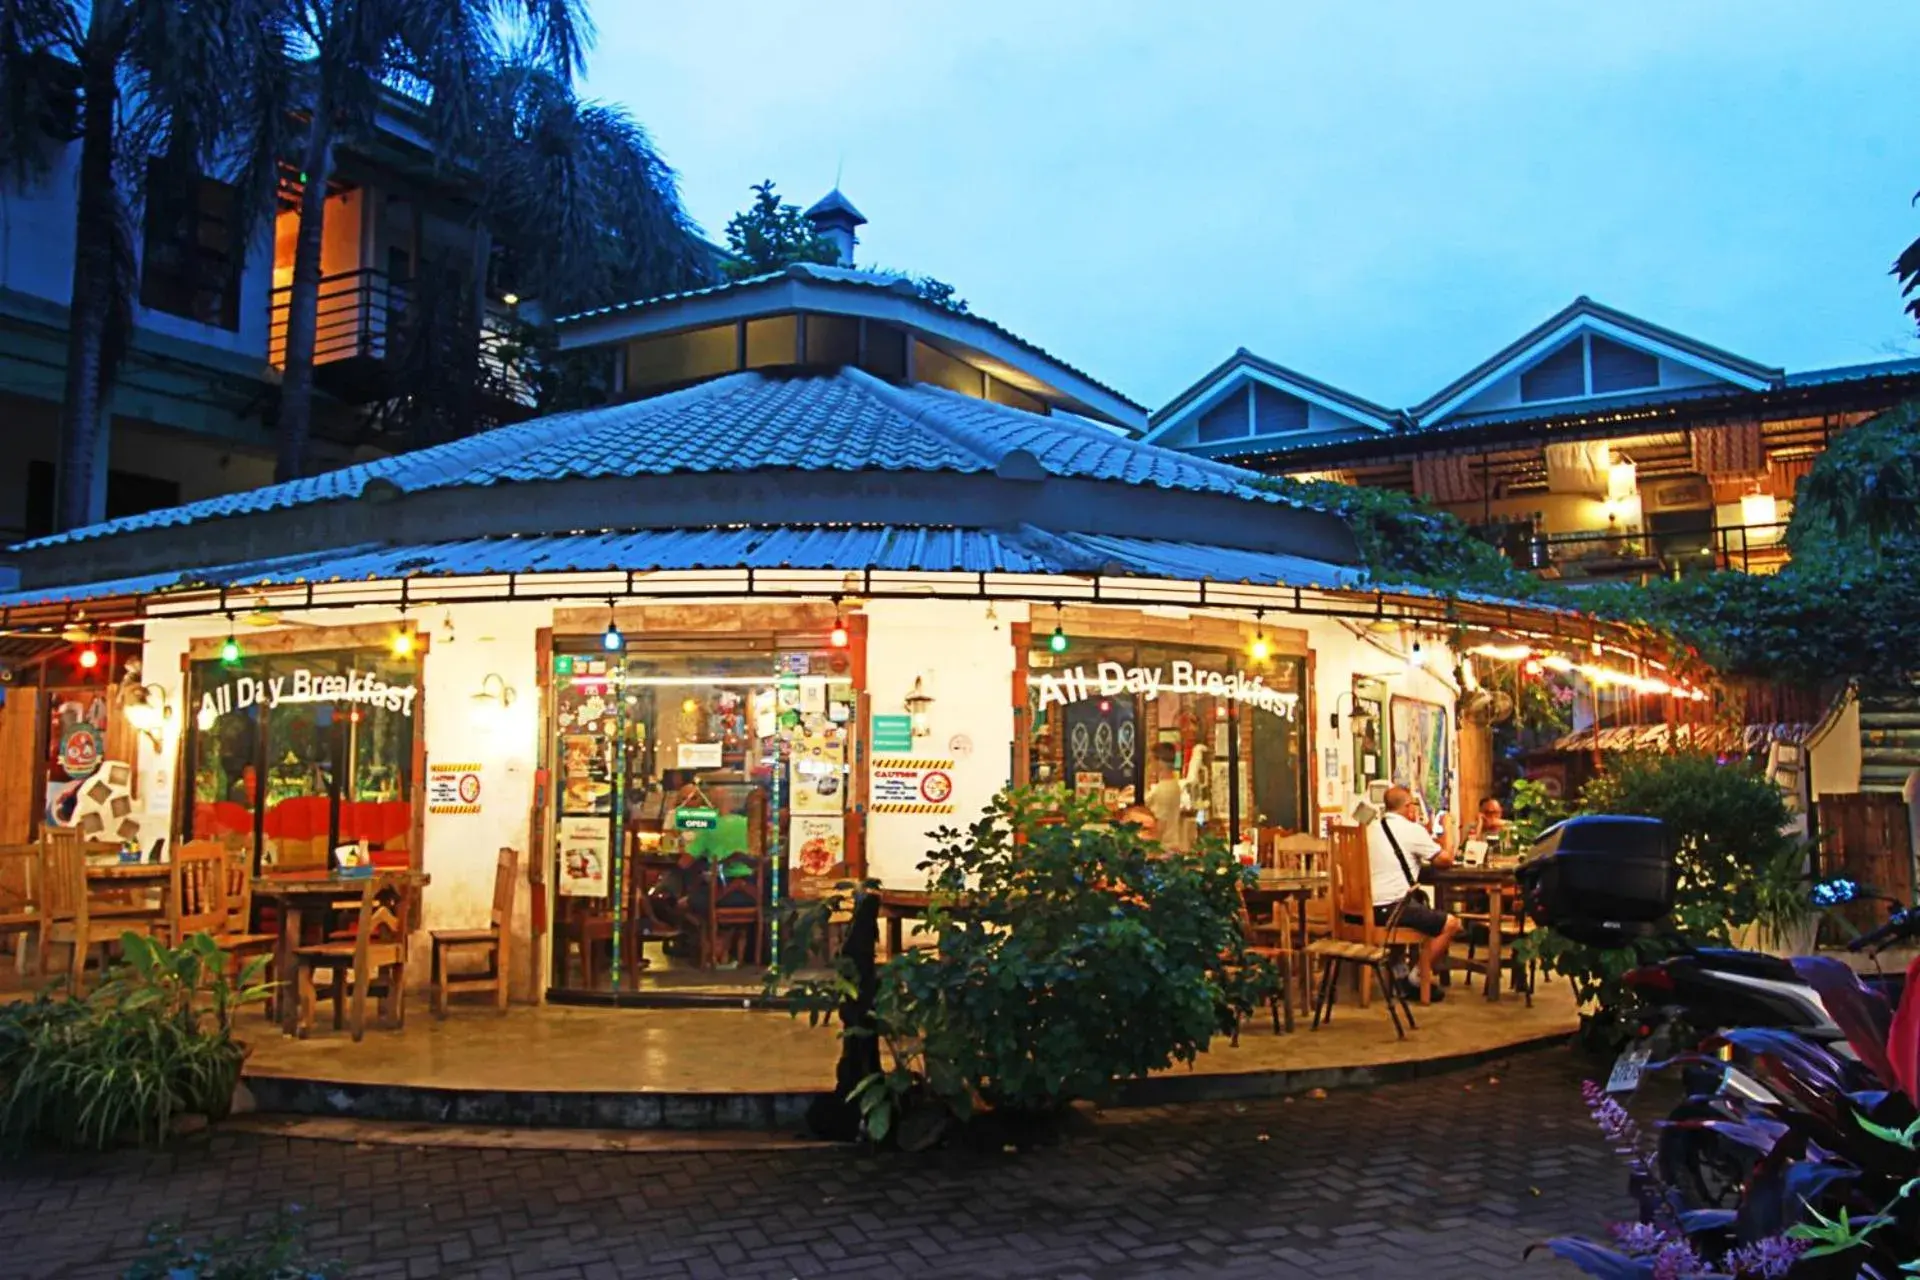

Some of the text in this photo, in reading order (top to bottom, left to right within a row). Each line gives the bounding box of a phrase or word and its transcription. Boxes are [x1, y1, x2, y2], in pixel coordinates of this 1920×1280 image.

[199, 669, 416, 717] All Day Breakfast
[1038, 660, 1298, 722] All Day Breakfast
[685, 820, 708, 828] OPEN
